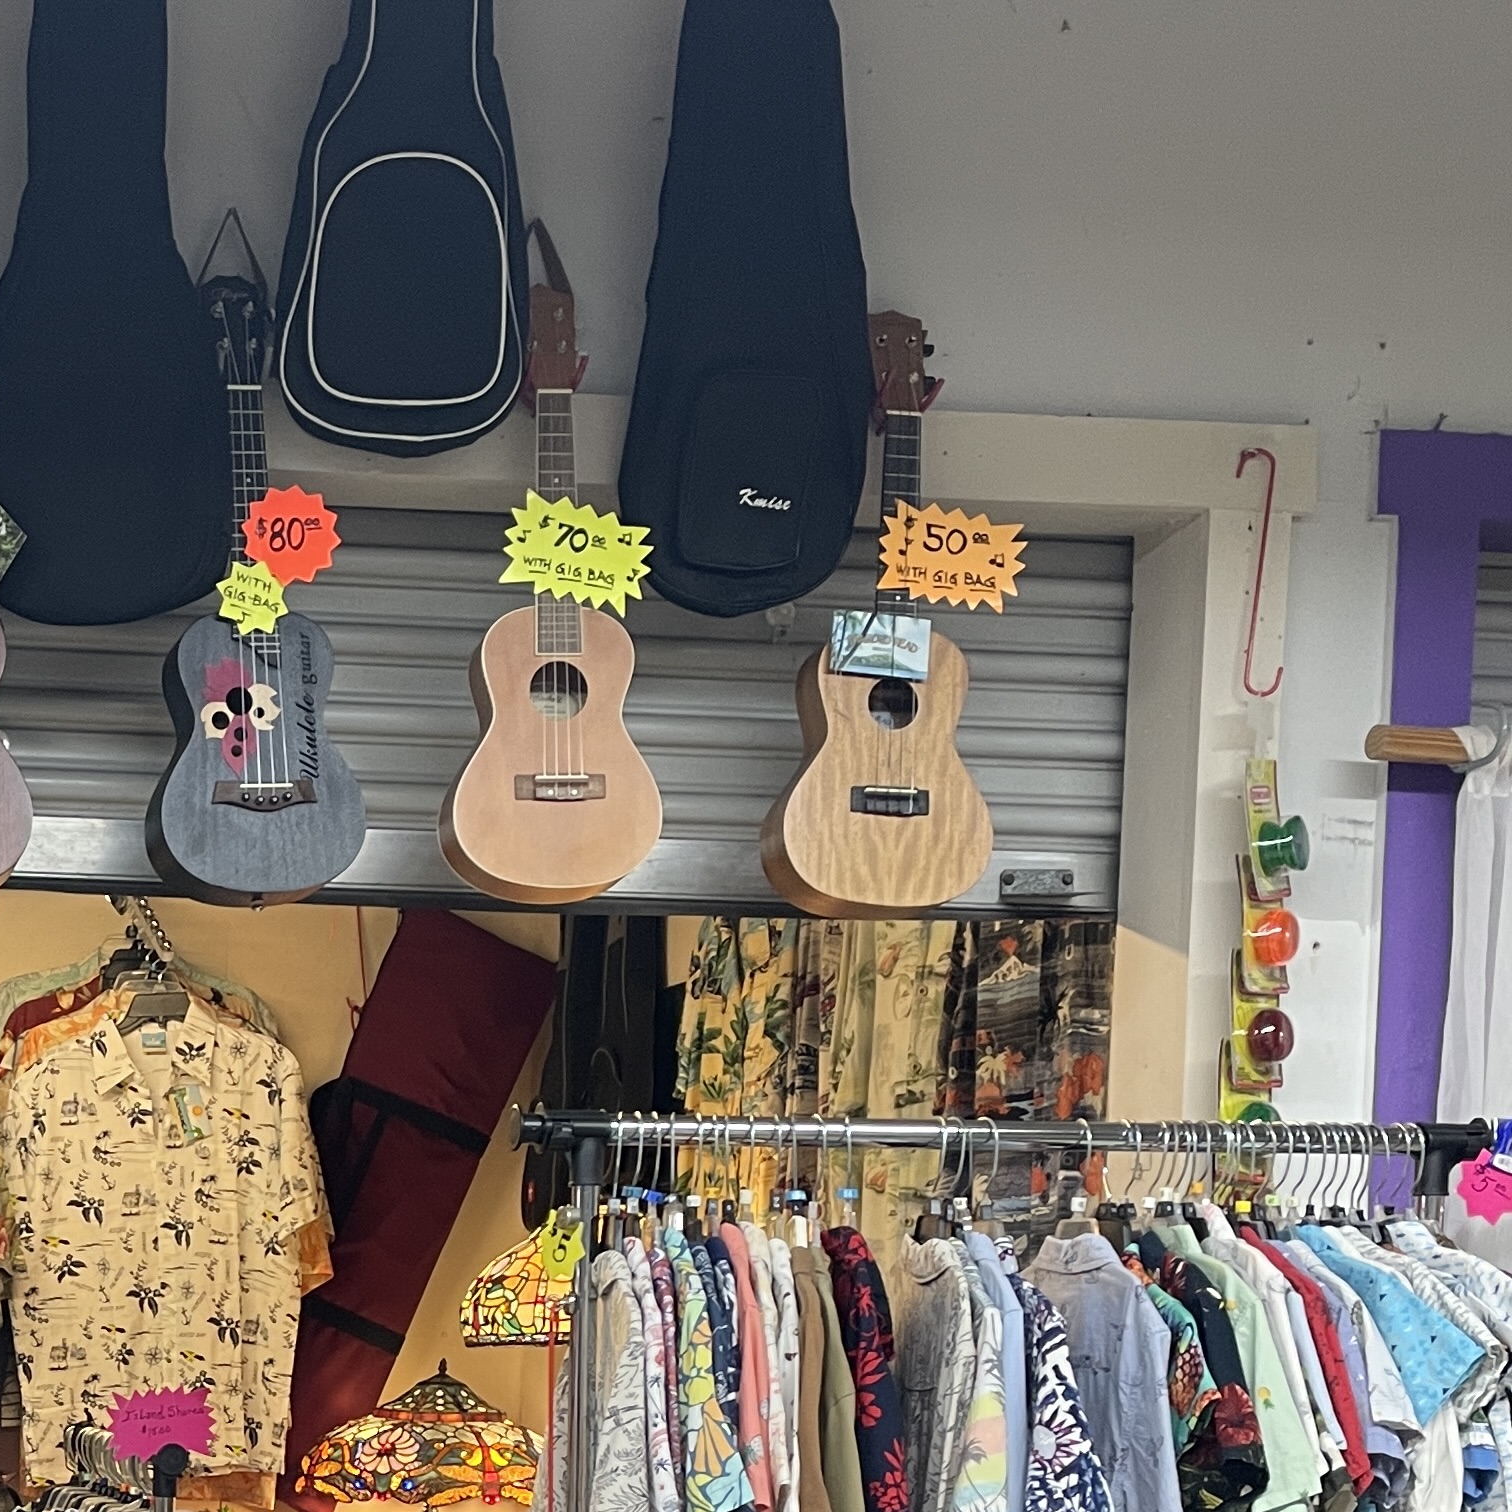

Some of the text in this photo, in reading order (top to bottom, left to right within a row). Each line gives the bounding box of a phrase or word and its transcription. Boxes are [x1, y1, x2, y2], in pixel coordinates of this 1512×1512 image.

[236, 571, 272, 594] WITH
[523, 556, 615, 588] WITH GIG BAG
[896, 564, 996, 590] WITH GIG BAG
[295, 692, 320, 781] Ukulele
